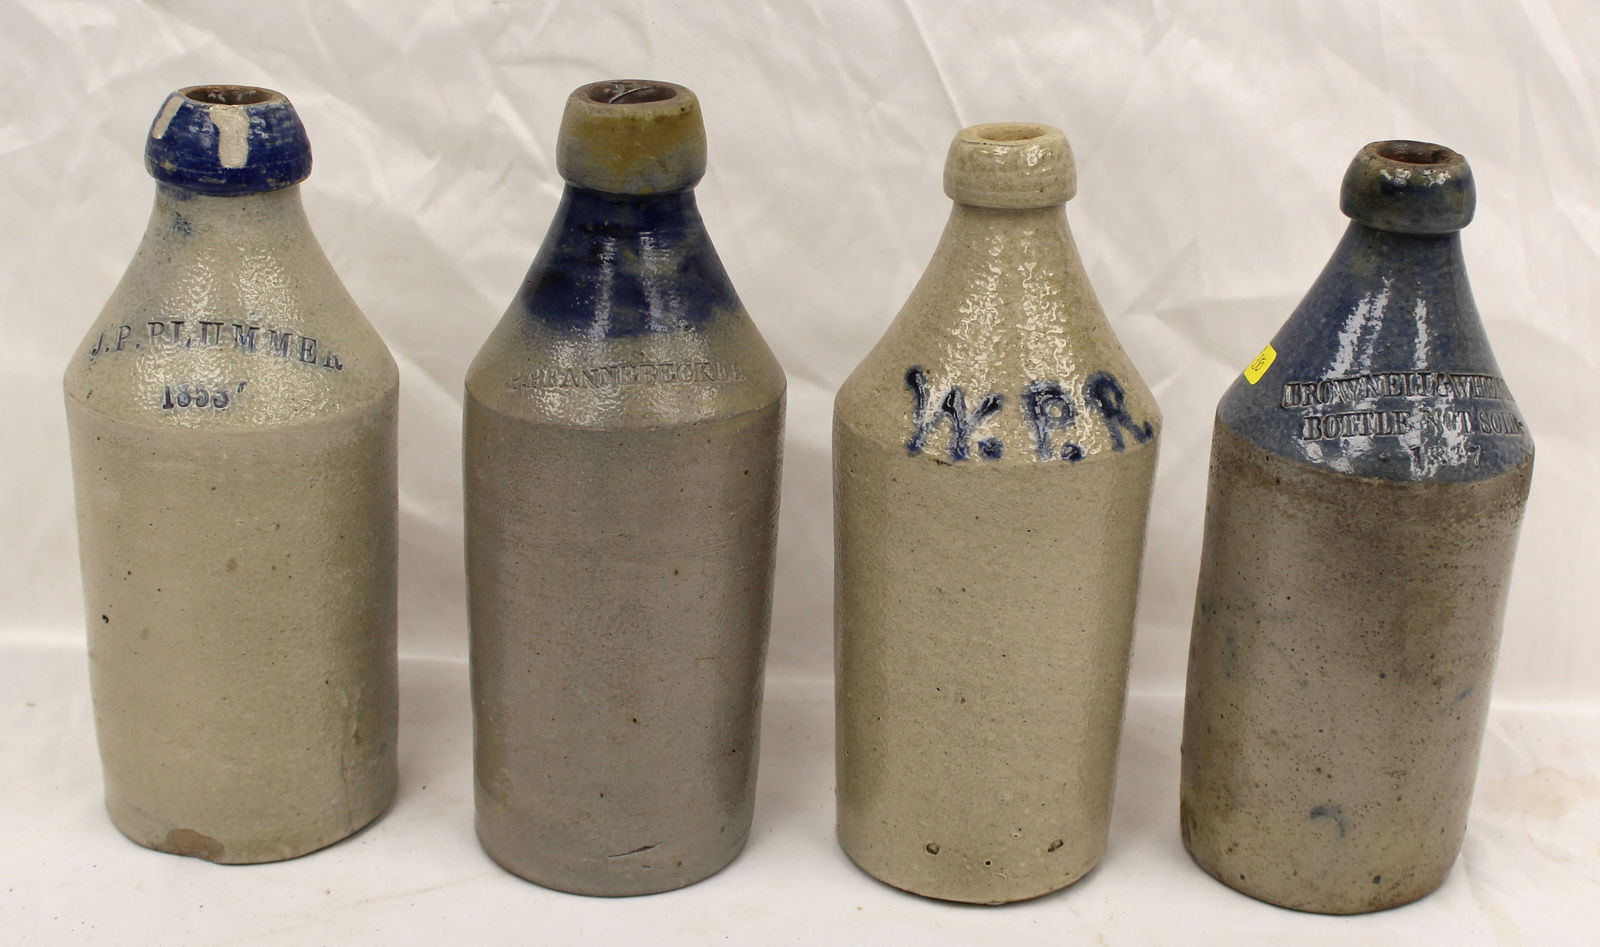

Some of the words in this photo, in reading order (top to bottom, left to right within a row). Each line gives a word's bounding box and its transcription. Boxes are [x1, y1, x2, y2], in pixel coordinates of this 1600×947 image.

[147, 320, 344, 371] PLUMMER
[1302, 410, 1410, 442] BOTTLE
[1422, 409, 1473, 436] NOT
